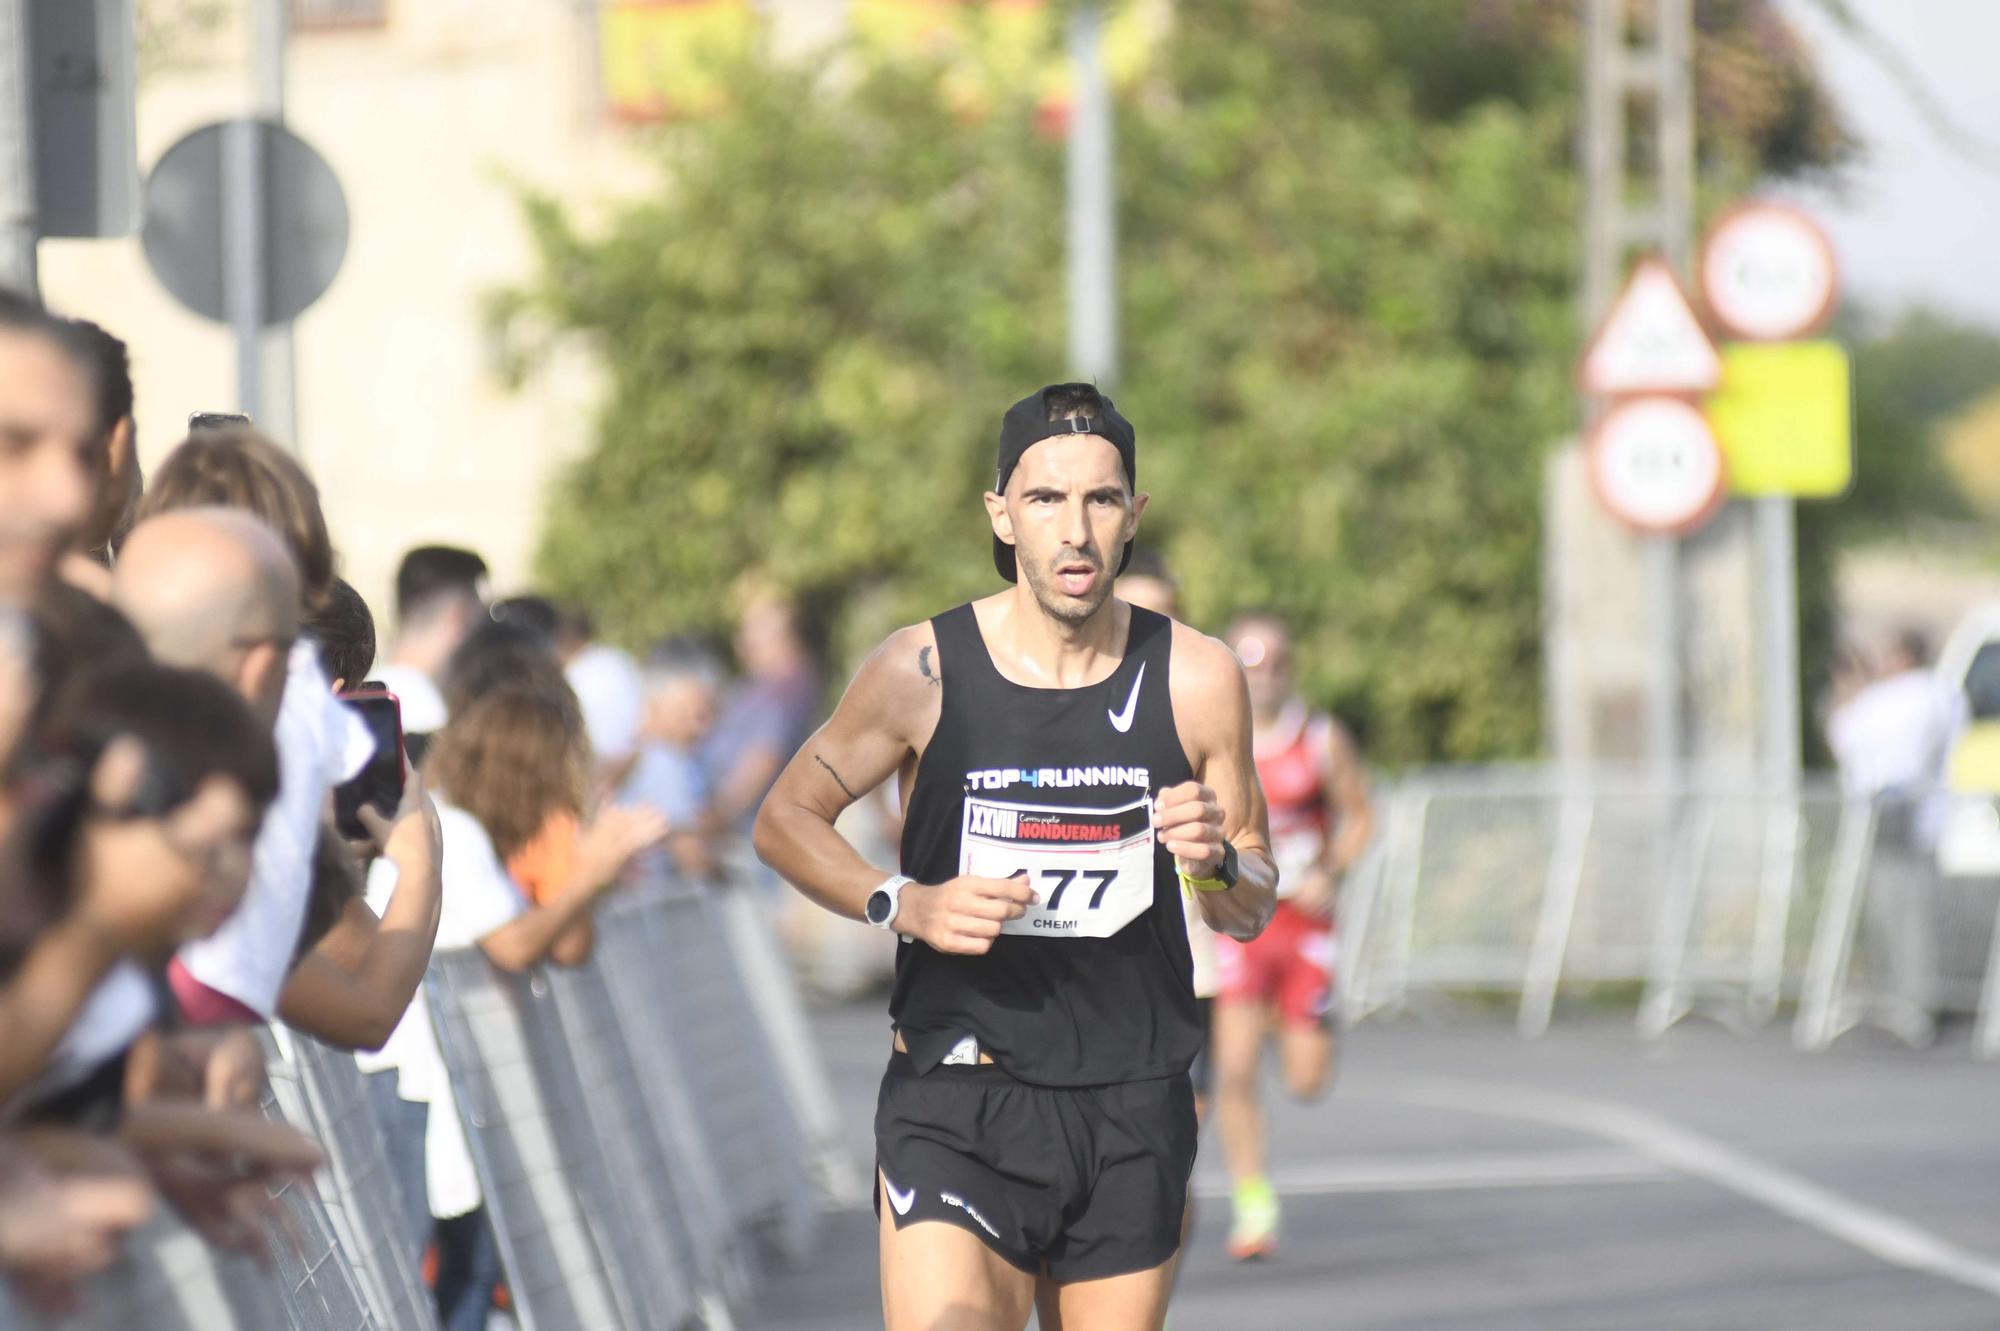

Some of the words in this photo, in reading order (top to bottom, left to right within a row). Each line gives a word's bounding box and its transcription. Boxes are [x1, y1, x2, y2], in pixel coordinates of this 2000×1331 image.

[966, 767, 1150, 790] TOP4RUNNING
[970, 804, 1018, 838] XXVIII
[1018, 822, 1121, 841] NONDUERMAS
[1033, 918, 1078, 930] CHEMI
